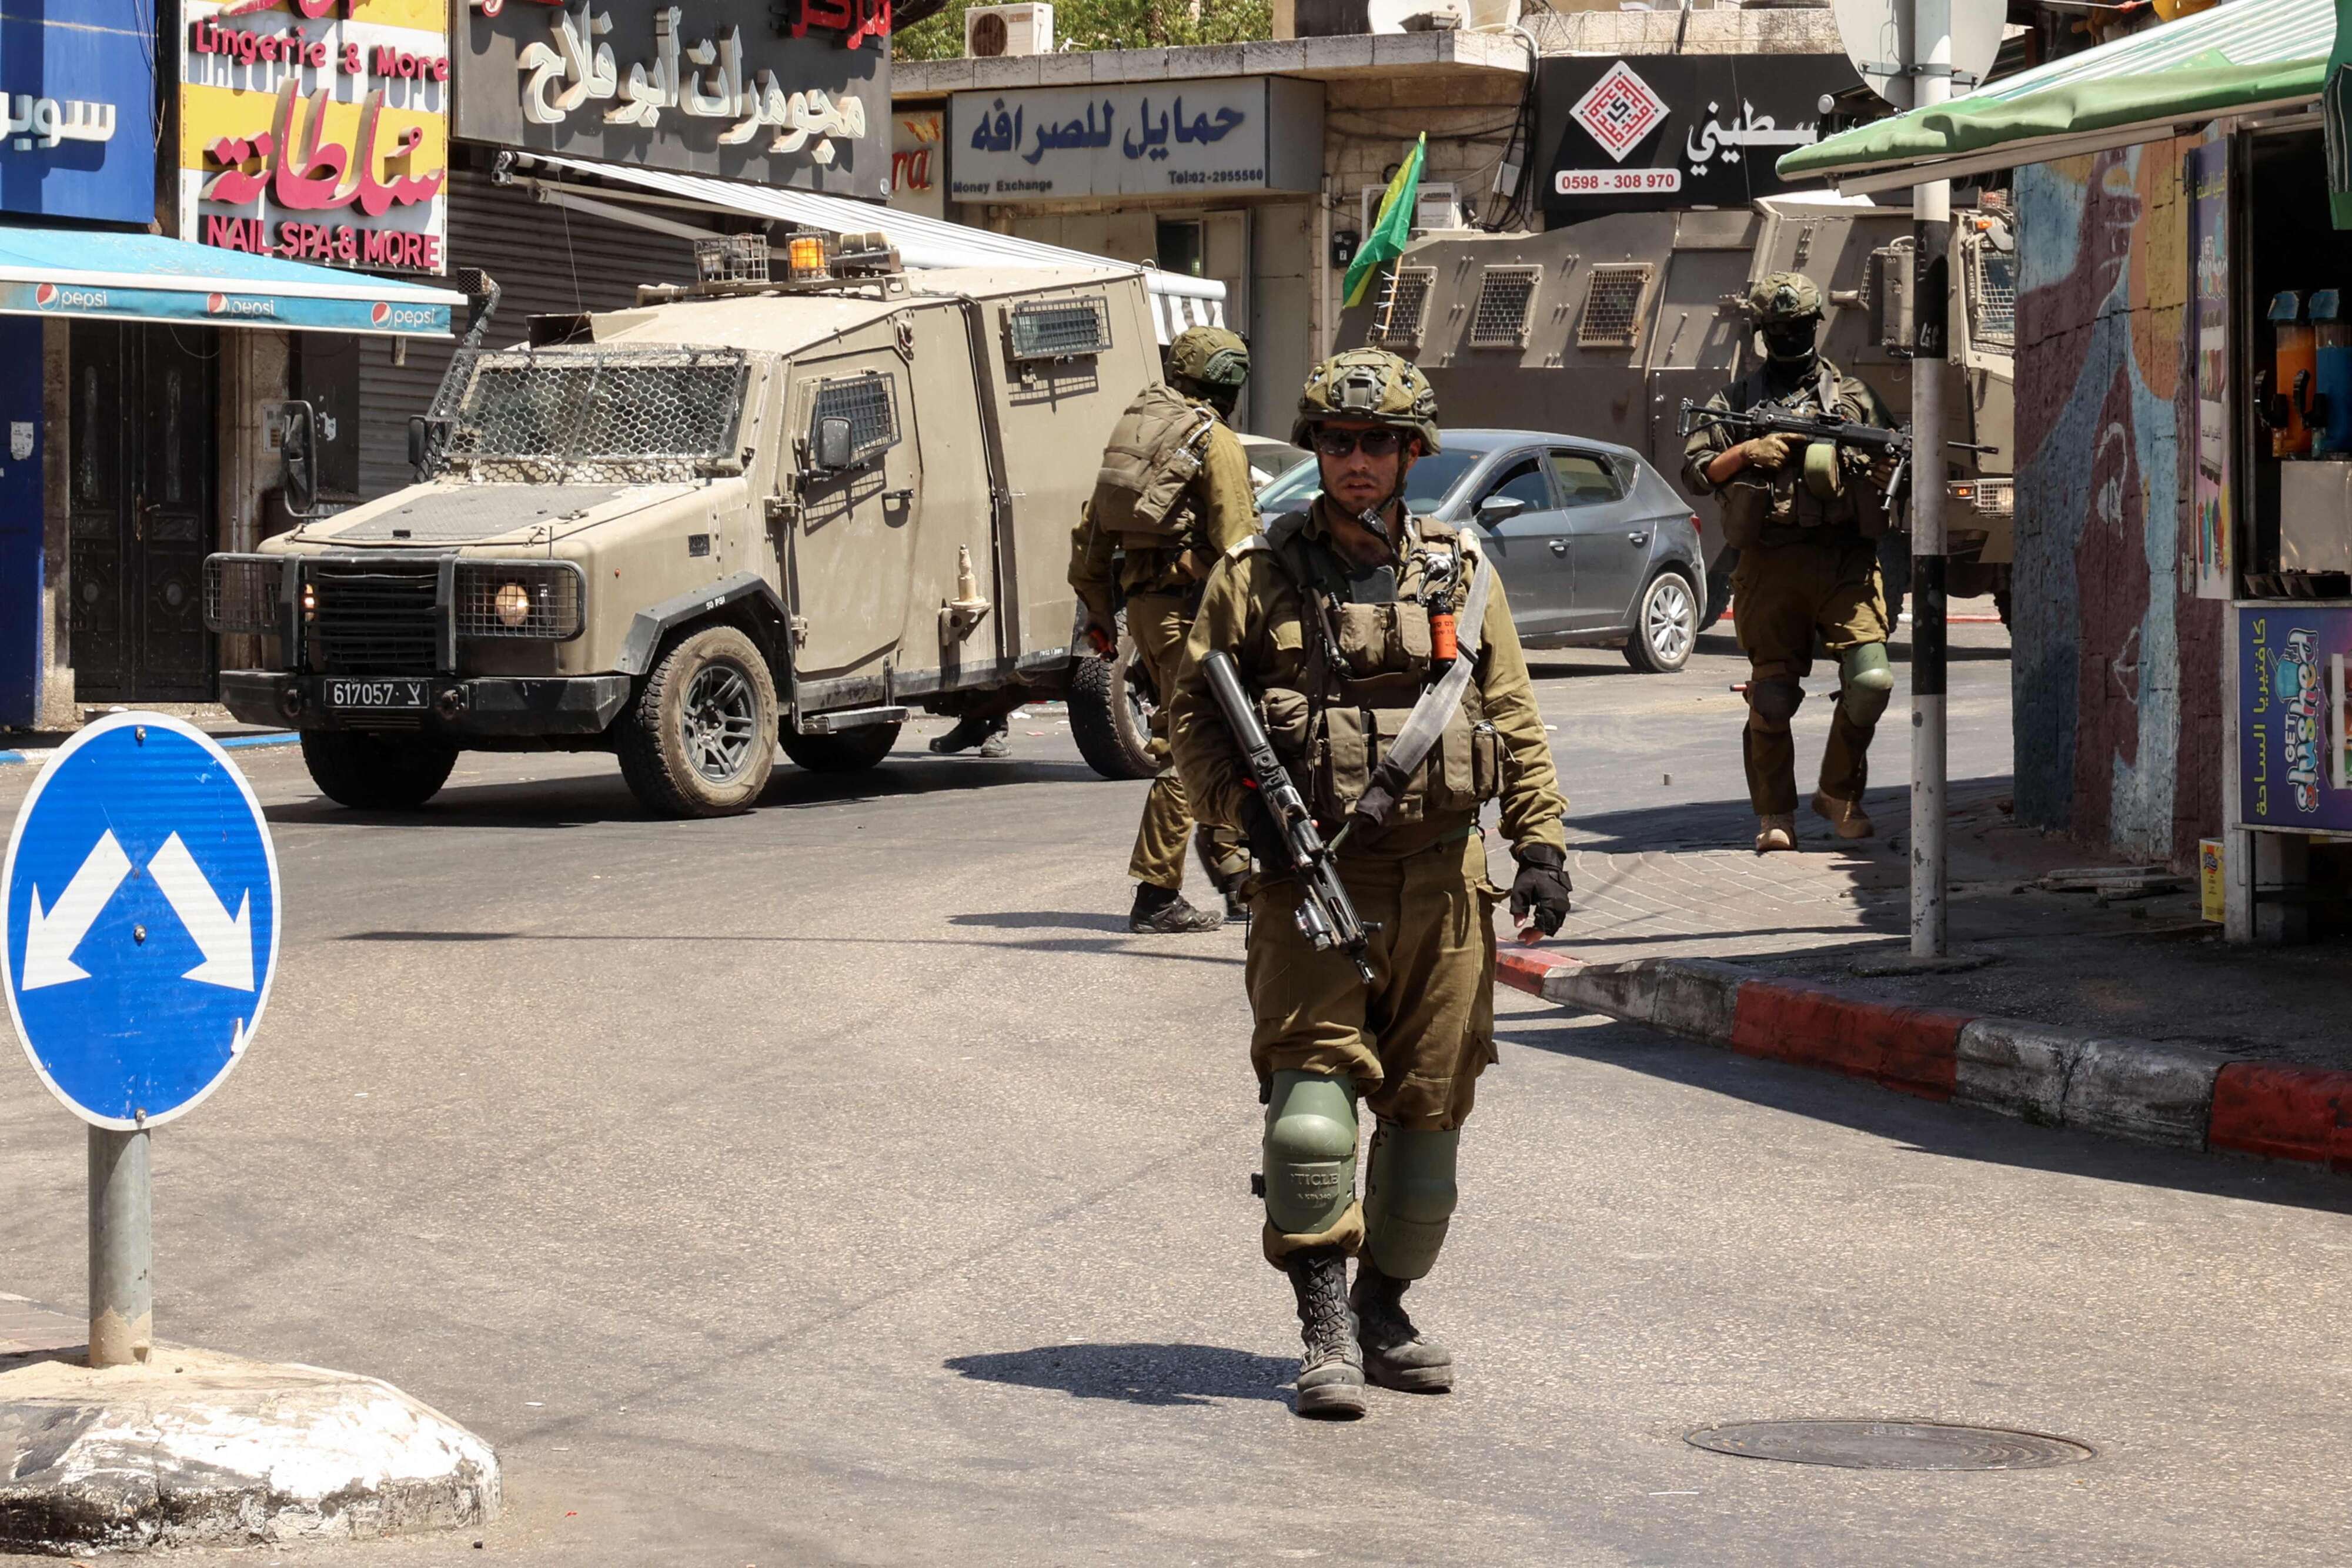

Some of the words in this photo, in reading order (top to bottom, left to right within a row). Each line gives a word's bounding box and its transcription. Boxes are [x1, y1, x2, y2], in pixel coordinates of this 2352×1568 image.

[196, 15, 327, 68] Lingerie
[344, 42, 362, 75] &
[376, 45, 449, 82] More
[523, 1, 617, 124] فلاح
[607, 6, 683, 128] أبو
[0, 92, 116, 152] سوب
[1123, 95, 1245, 162] حمايل
[1686, 97, 1820, 176] سطيني
[953, 182, 990, 194] Money
[997, 179, 1053, 192] Exchange
[1562, 176, 1599, 189] 0598
[1614, 175, 1642, 188] 308
[1647, 174, 1675, 188] 970
[208, 215, 273, 253] NAIL
[282, 222, 335, 259] SPA
[338, 226, 358, 259] &
[364, 229, 441, 268] MORE
[61, 292, 107, 309] pepsi
[230, 299, 275, 316] pepsi
[393, 306, 436, 327] pepsi
[714, 596, 725, 606] PSI
[2253, 618, 2269, 713] كافتيريا
[334, 684, 393, 705] 617057
[2287, 628, 2319, 813] slushed
[2284, 714, 2298, 763] GET
[2253, 718, 2268, 816] الساحة
